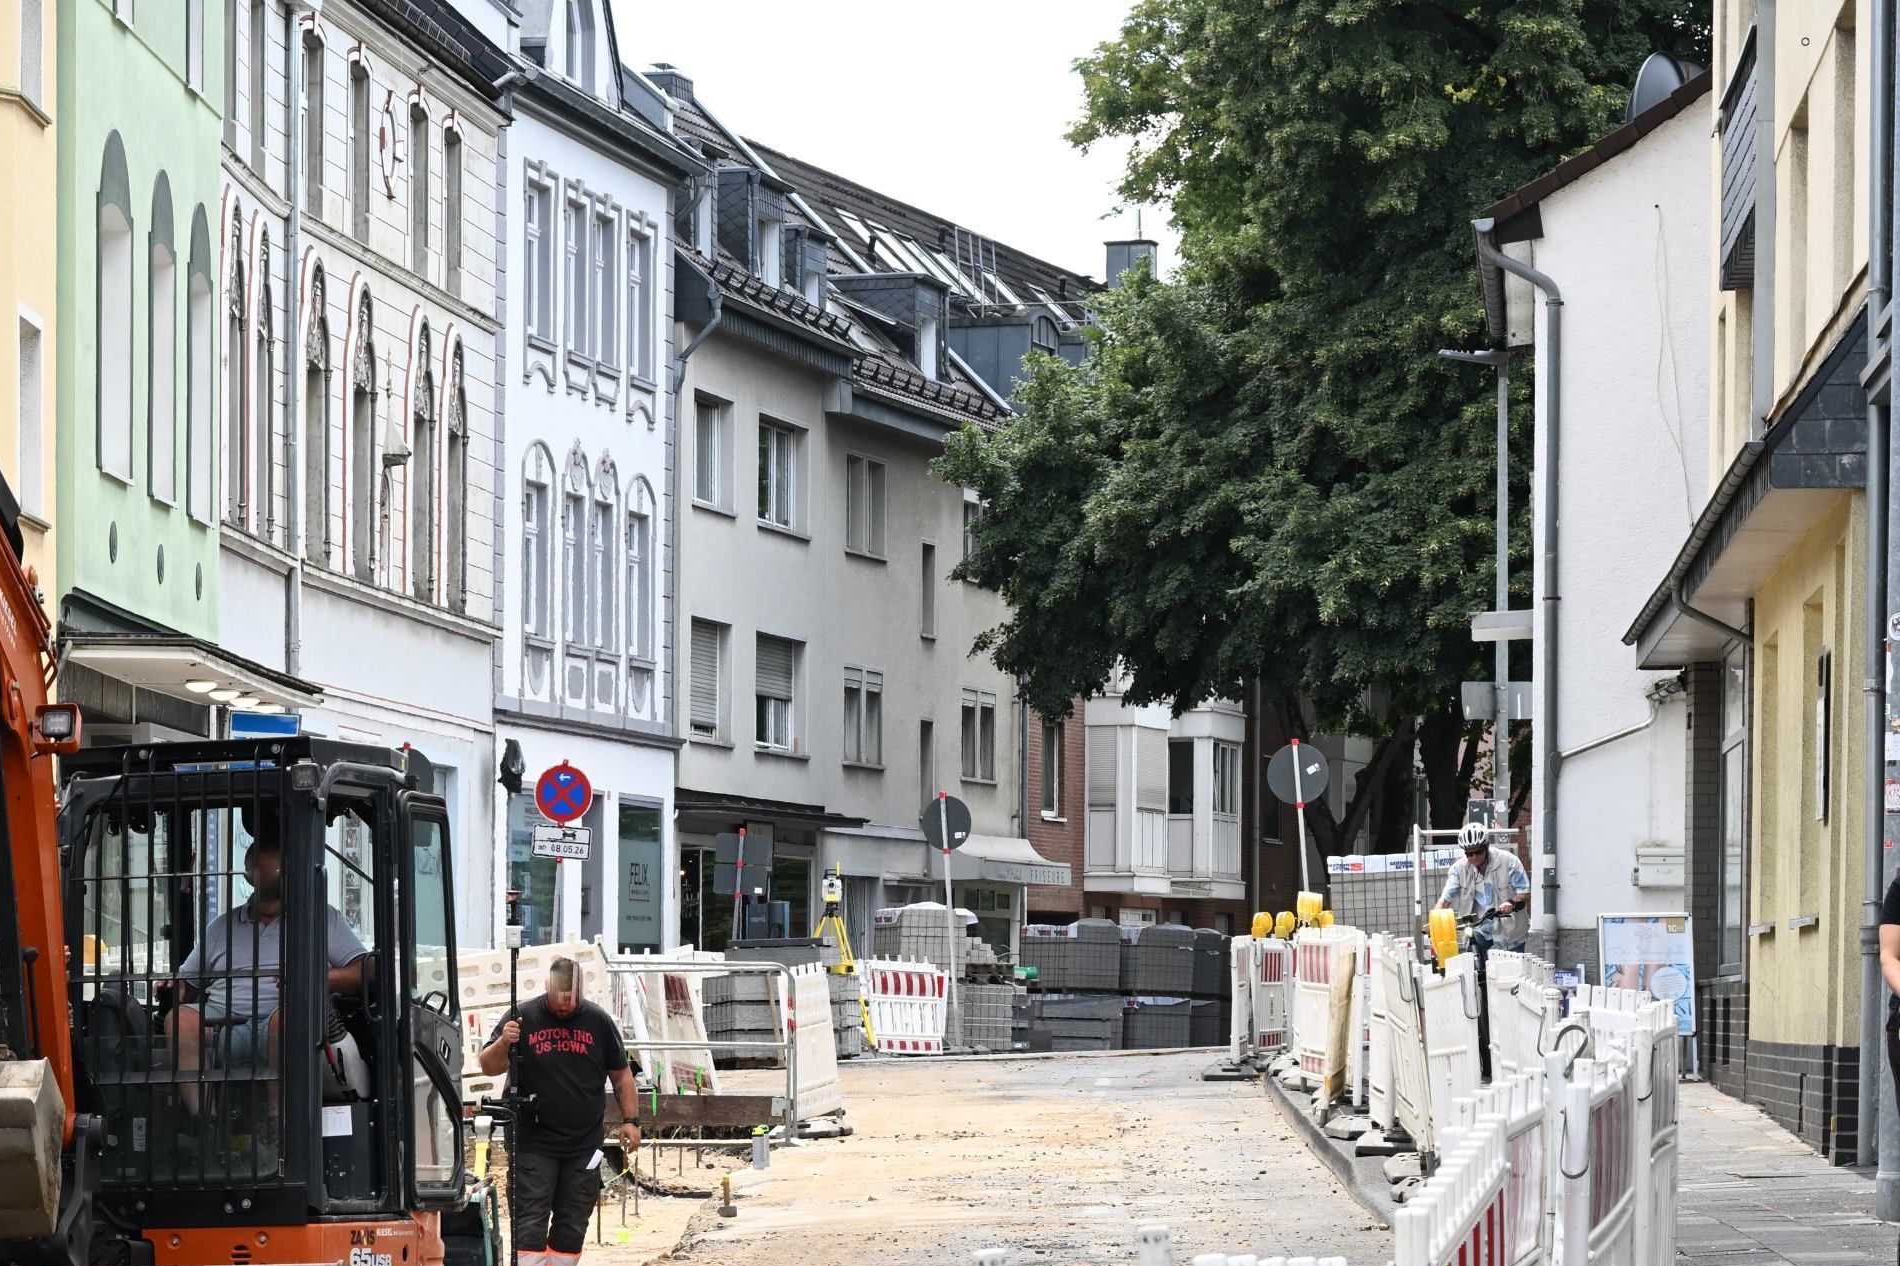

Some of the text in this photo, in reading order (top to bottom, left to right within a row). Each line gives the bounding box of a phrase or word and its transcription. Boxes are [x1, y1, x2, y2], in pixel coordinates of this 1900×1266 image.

[550, 843, 585, 855] 08.05.26
[630, 862, 649, 886] FELIX
[528, 1028, 571, 1046] MOTOR
[535, 1040, 589, 1055] US-IOWA
